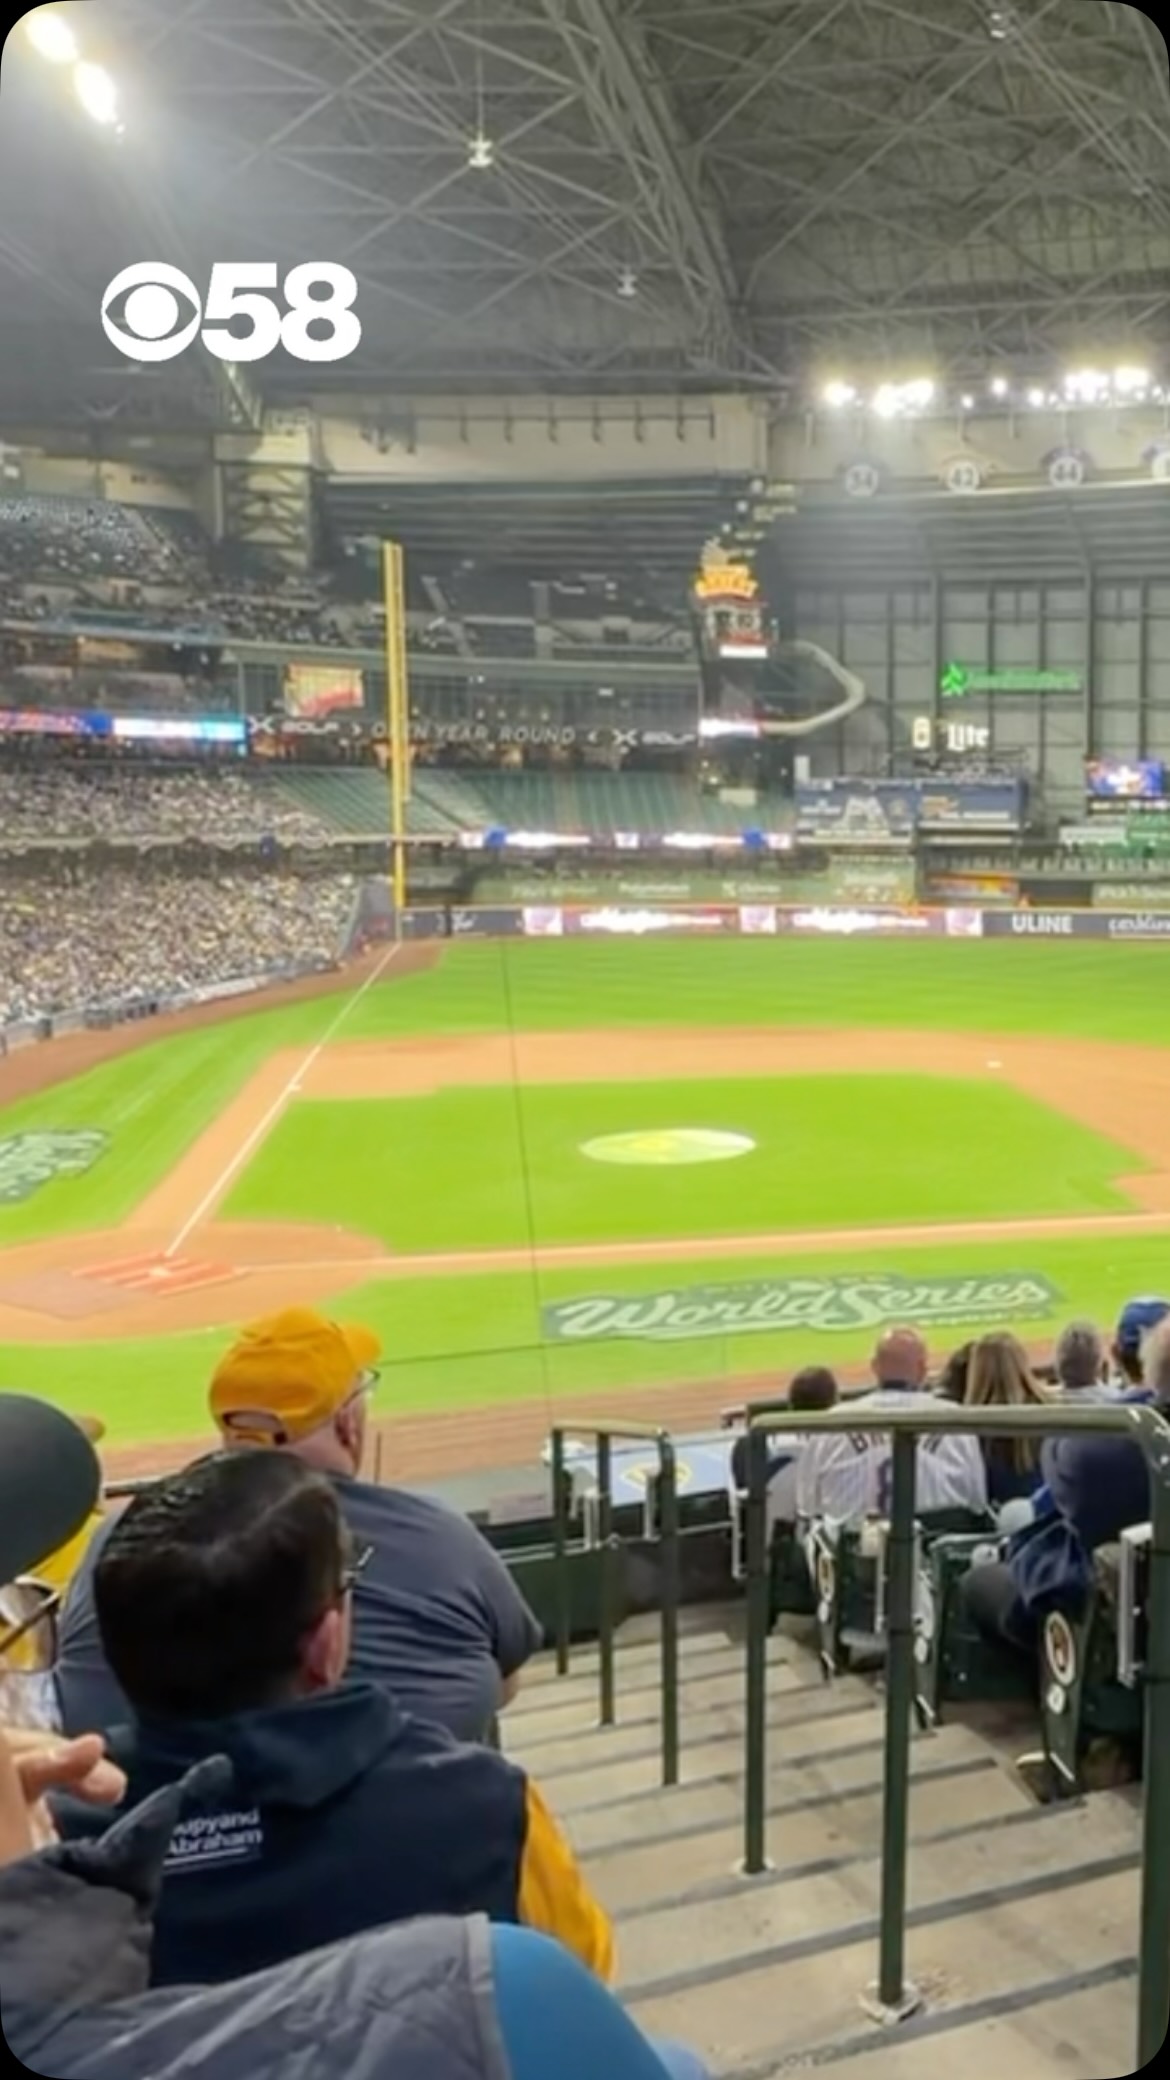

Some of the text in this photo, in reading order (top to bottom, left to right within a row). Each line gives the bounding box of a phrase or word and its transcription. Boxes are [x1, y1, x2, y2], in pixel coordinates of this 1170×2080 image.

[1055, 464, 1079, 482] 44
[436, 723, 488, 742] YEAR
[499, 725, 577, 745] ROUND
[946, 722, 990, 751] Lite
[1012, 913, 1072, 934] ULINE
[556, 1278, 1051, 1338] World Series
[168, 1829, 264, 1856] Abraham
